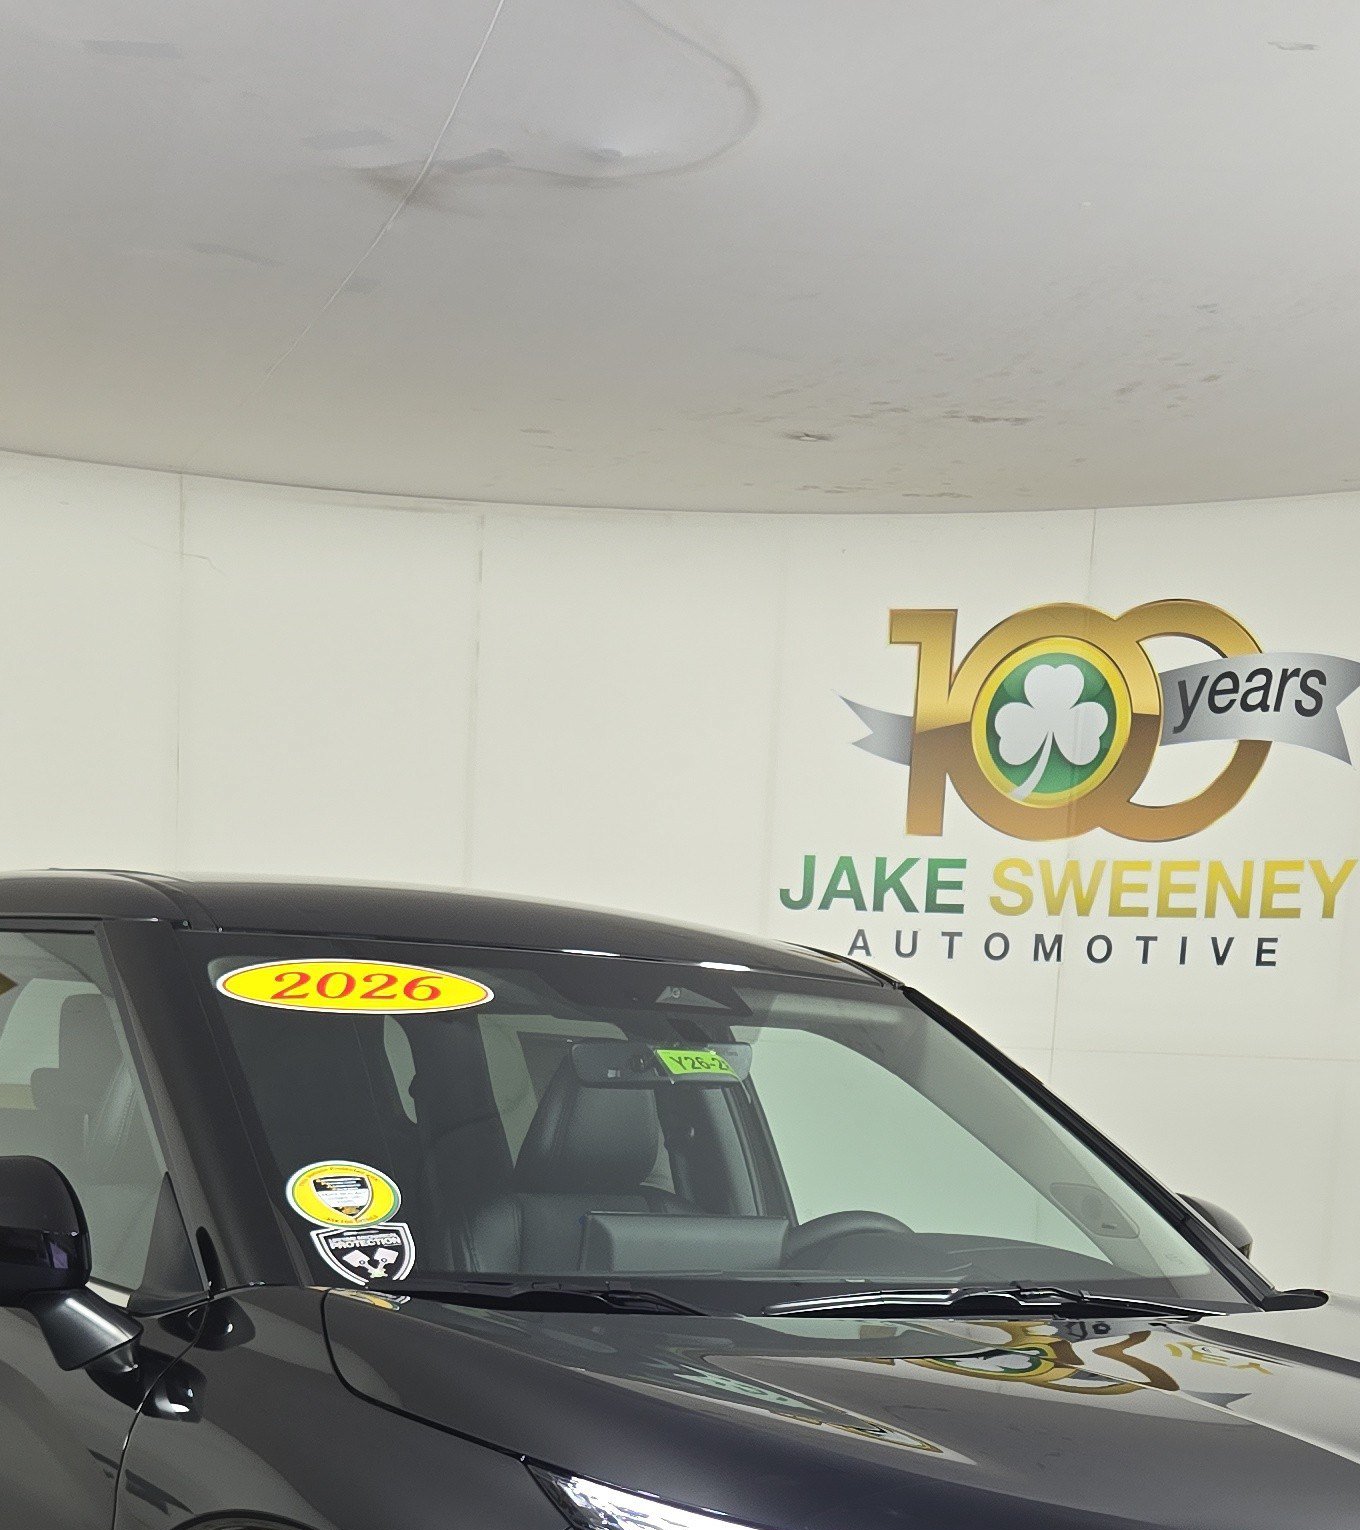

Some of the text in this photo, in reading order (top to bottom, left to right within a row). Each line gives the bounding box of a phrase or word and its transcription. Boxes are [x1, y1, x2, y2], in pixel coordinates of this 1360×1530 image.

[889, 599, 1327, 842] 100 years
[779, 855, 1359, 919] JAKE SWEENEY
[848, 929, 1279, 968] AUTOMOTIVE
[271, 971, 444, 1002] 2026
[329, 1236, 402, 1250] PROTECTION
